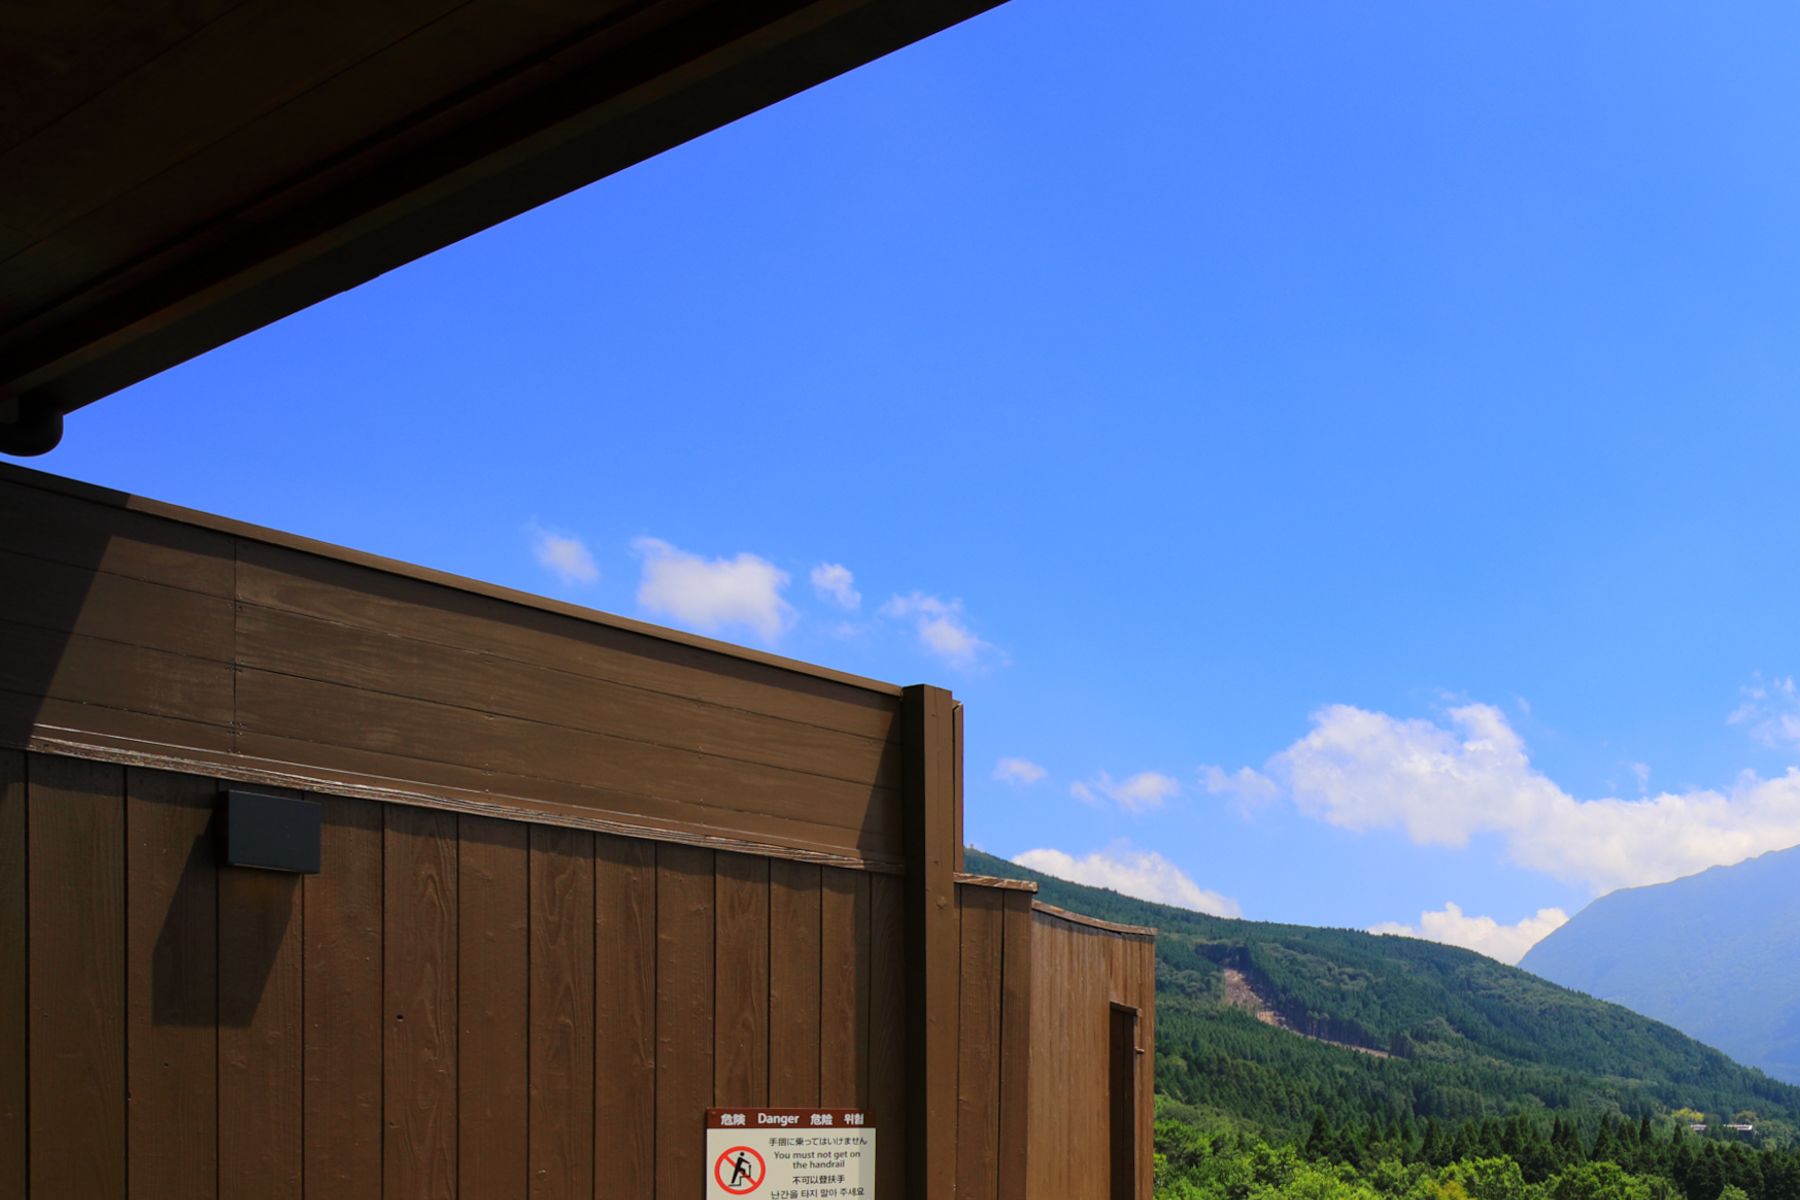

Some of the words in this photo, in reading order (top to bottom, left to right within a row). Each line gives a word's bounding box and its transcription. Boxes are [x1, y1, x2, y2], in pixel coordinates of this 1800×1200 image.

[758, 1112, 799, 1126] Danger
[843, 1113, 865, 1125] 위험
[774, 1151, 790, 1159] You
[817, 1151, 832, 1159] not
[833, 1151, 848, 1160] get
[792, 1161, 808, 1169] the
[809, 1160, 845, 1169] handrail
[771, 1190, 798, 1200] 난간을
[801, 1189, 818, 1199] 타지
[820, 1188, 837, 1198] 말아
[840, 1187, 865, 1197] 주세요
